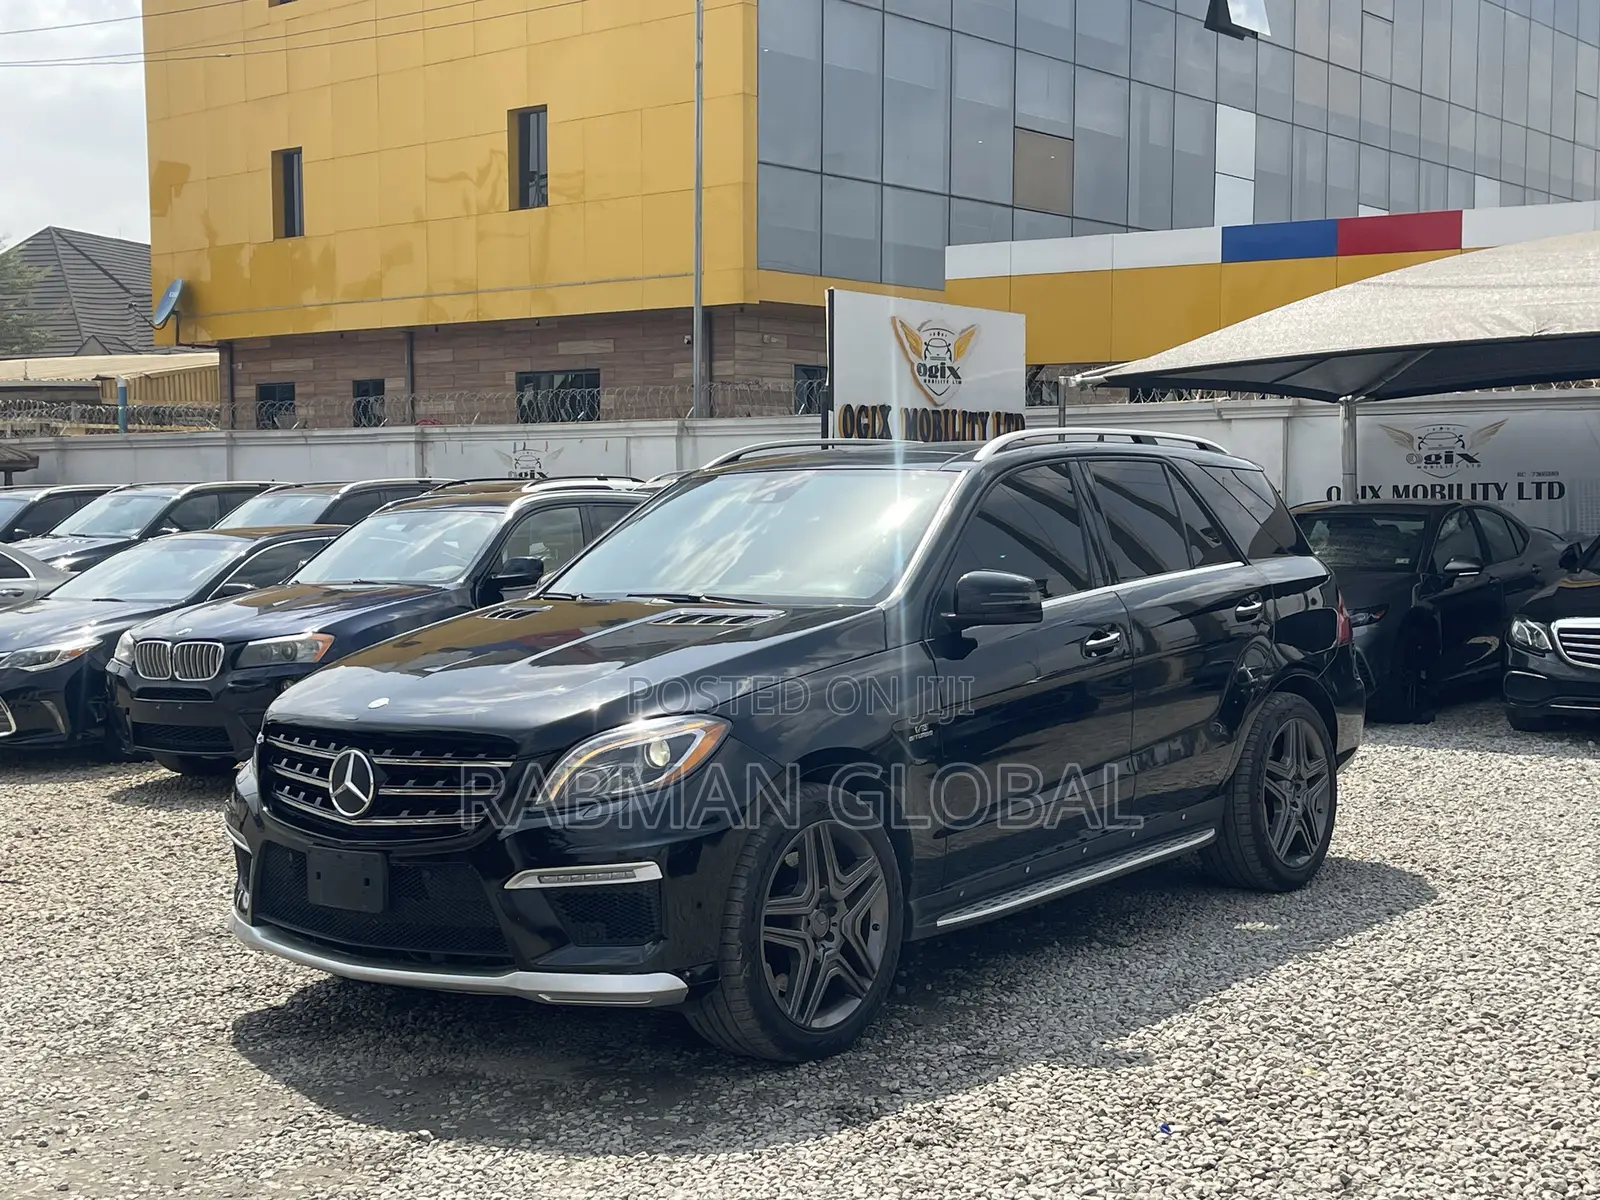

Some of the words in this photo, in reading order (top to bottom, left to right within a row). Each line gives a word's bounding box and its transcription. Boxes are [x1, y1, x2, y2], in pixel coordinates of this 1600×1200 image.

[838, 403, 892, 439] OGIX
[900, 408, 990, 442] MOBILITY
[1326, 485, 1382, 501] OIX
[1392, 482, 1508, 500] MOBILITY
[1517, 481, 1566, 500] LTD
